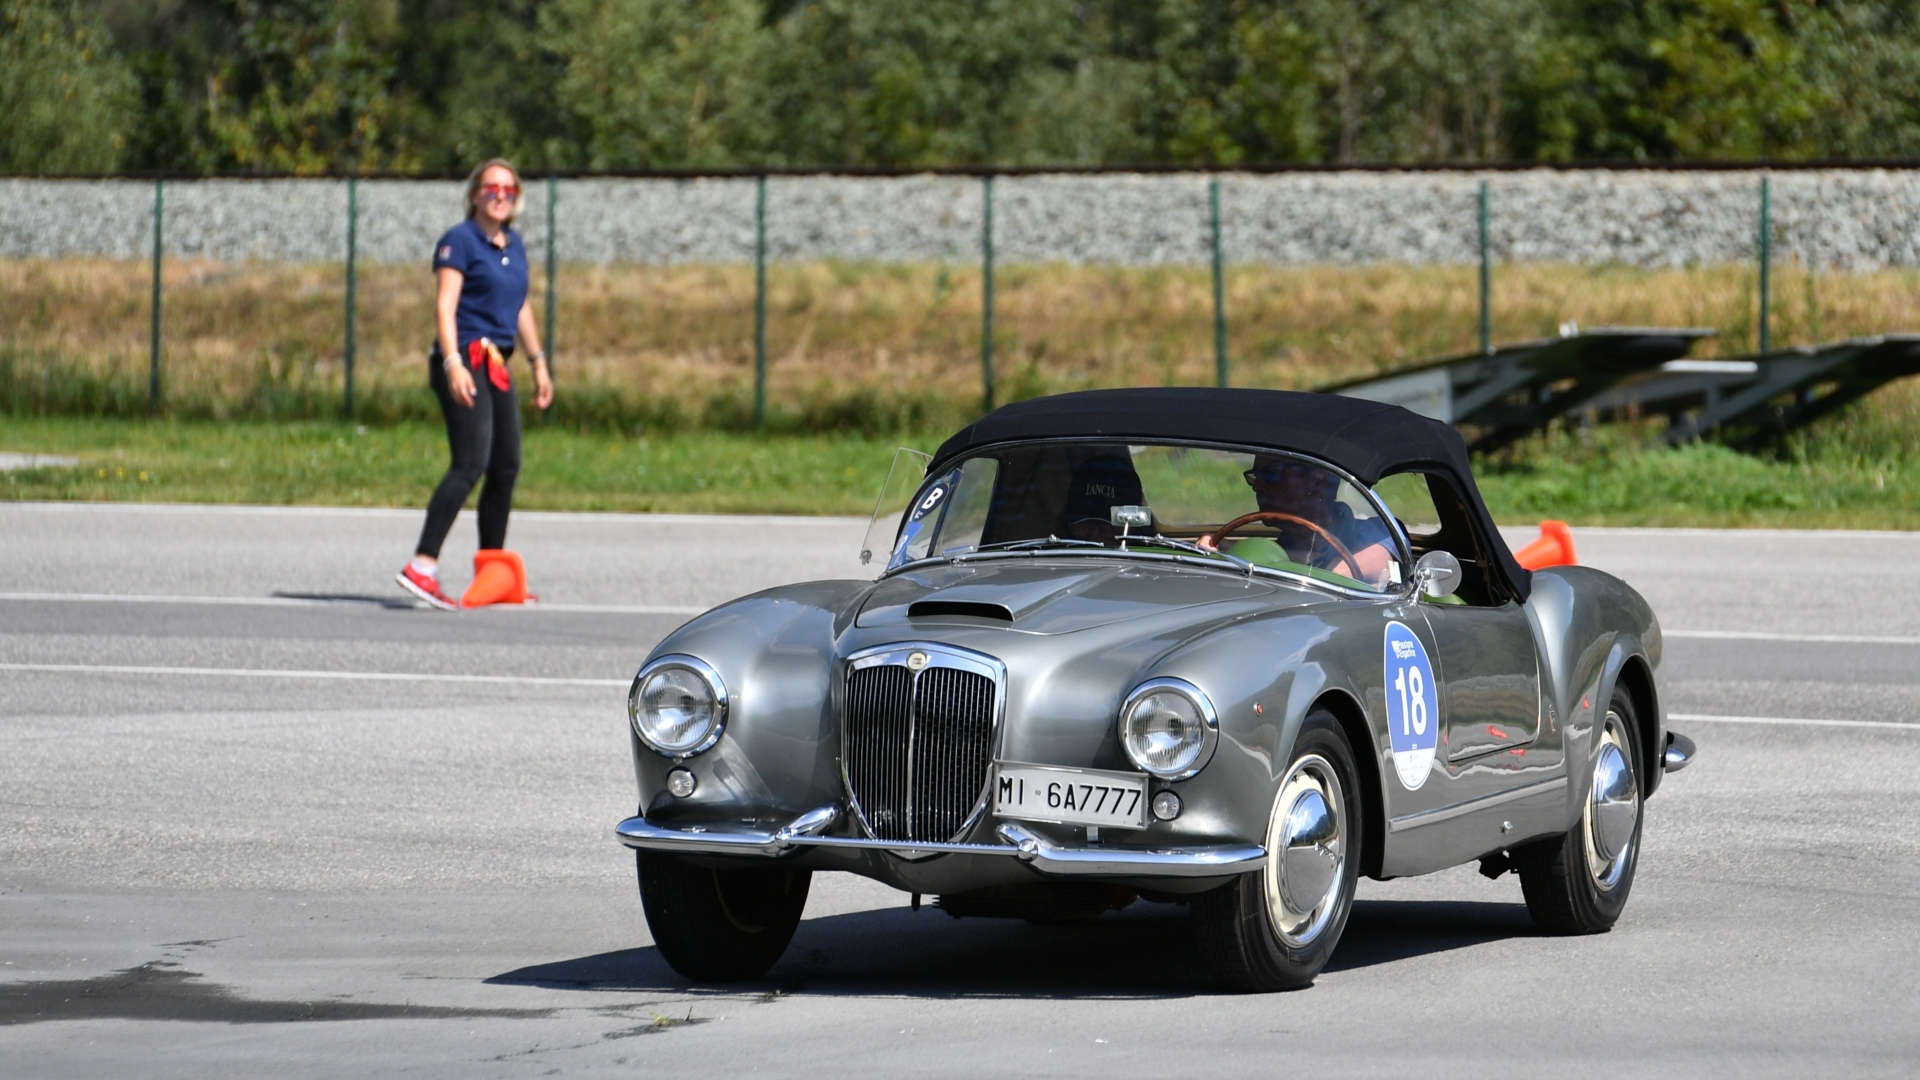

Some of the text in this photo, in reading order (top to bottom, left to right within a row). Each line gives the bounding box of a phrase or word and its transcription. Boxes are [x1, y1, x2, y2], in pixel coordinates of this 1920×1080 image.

[921, 487, 943, 510] B
[1086, 483, 1115, 498] LANCIA
[1395, 665, 1427, 736] 18
[998, 776, 1142, 816] MI 6A7777
